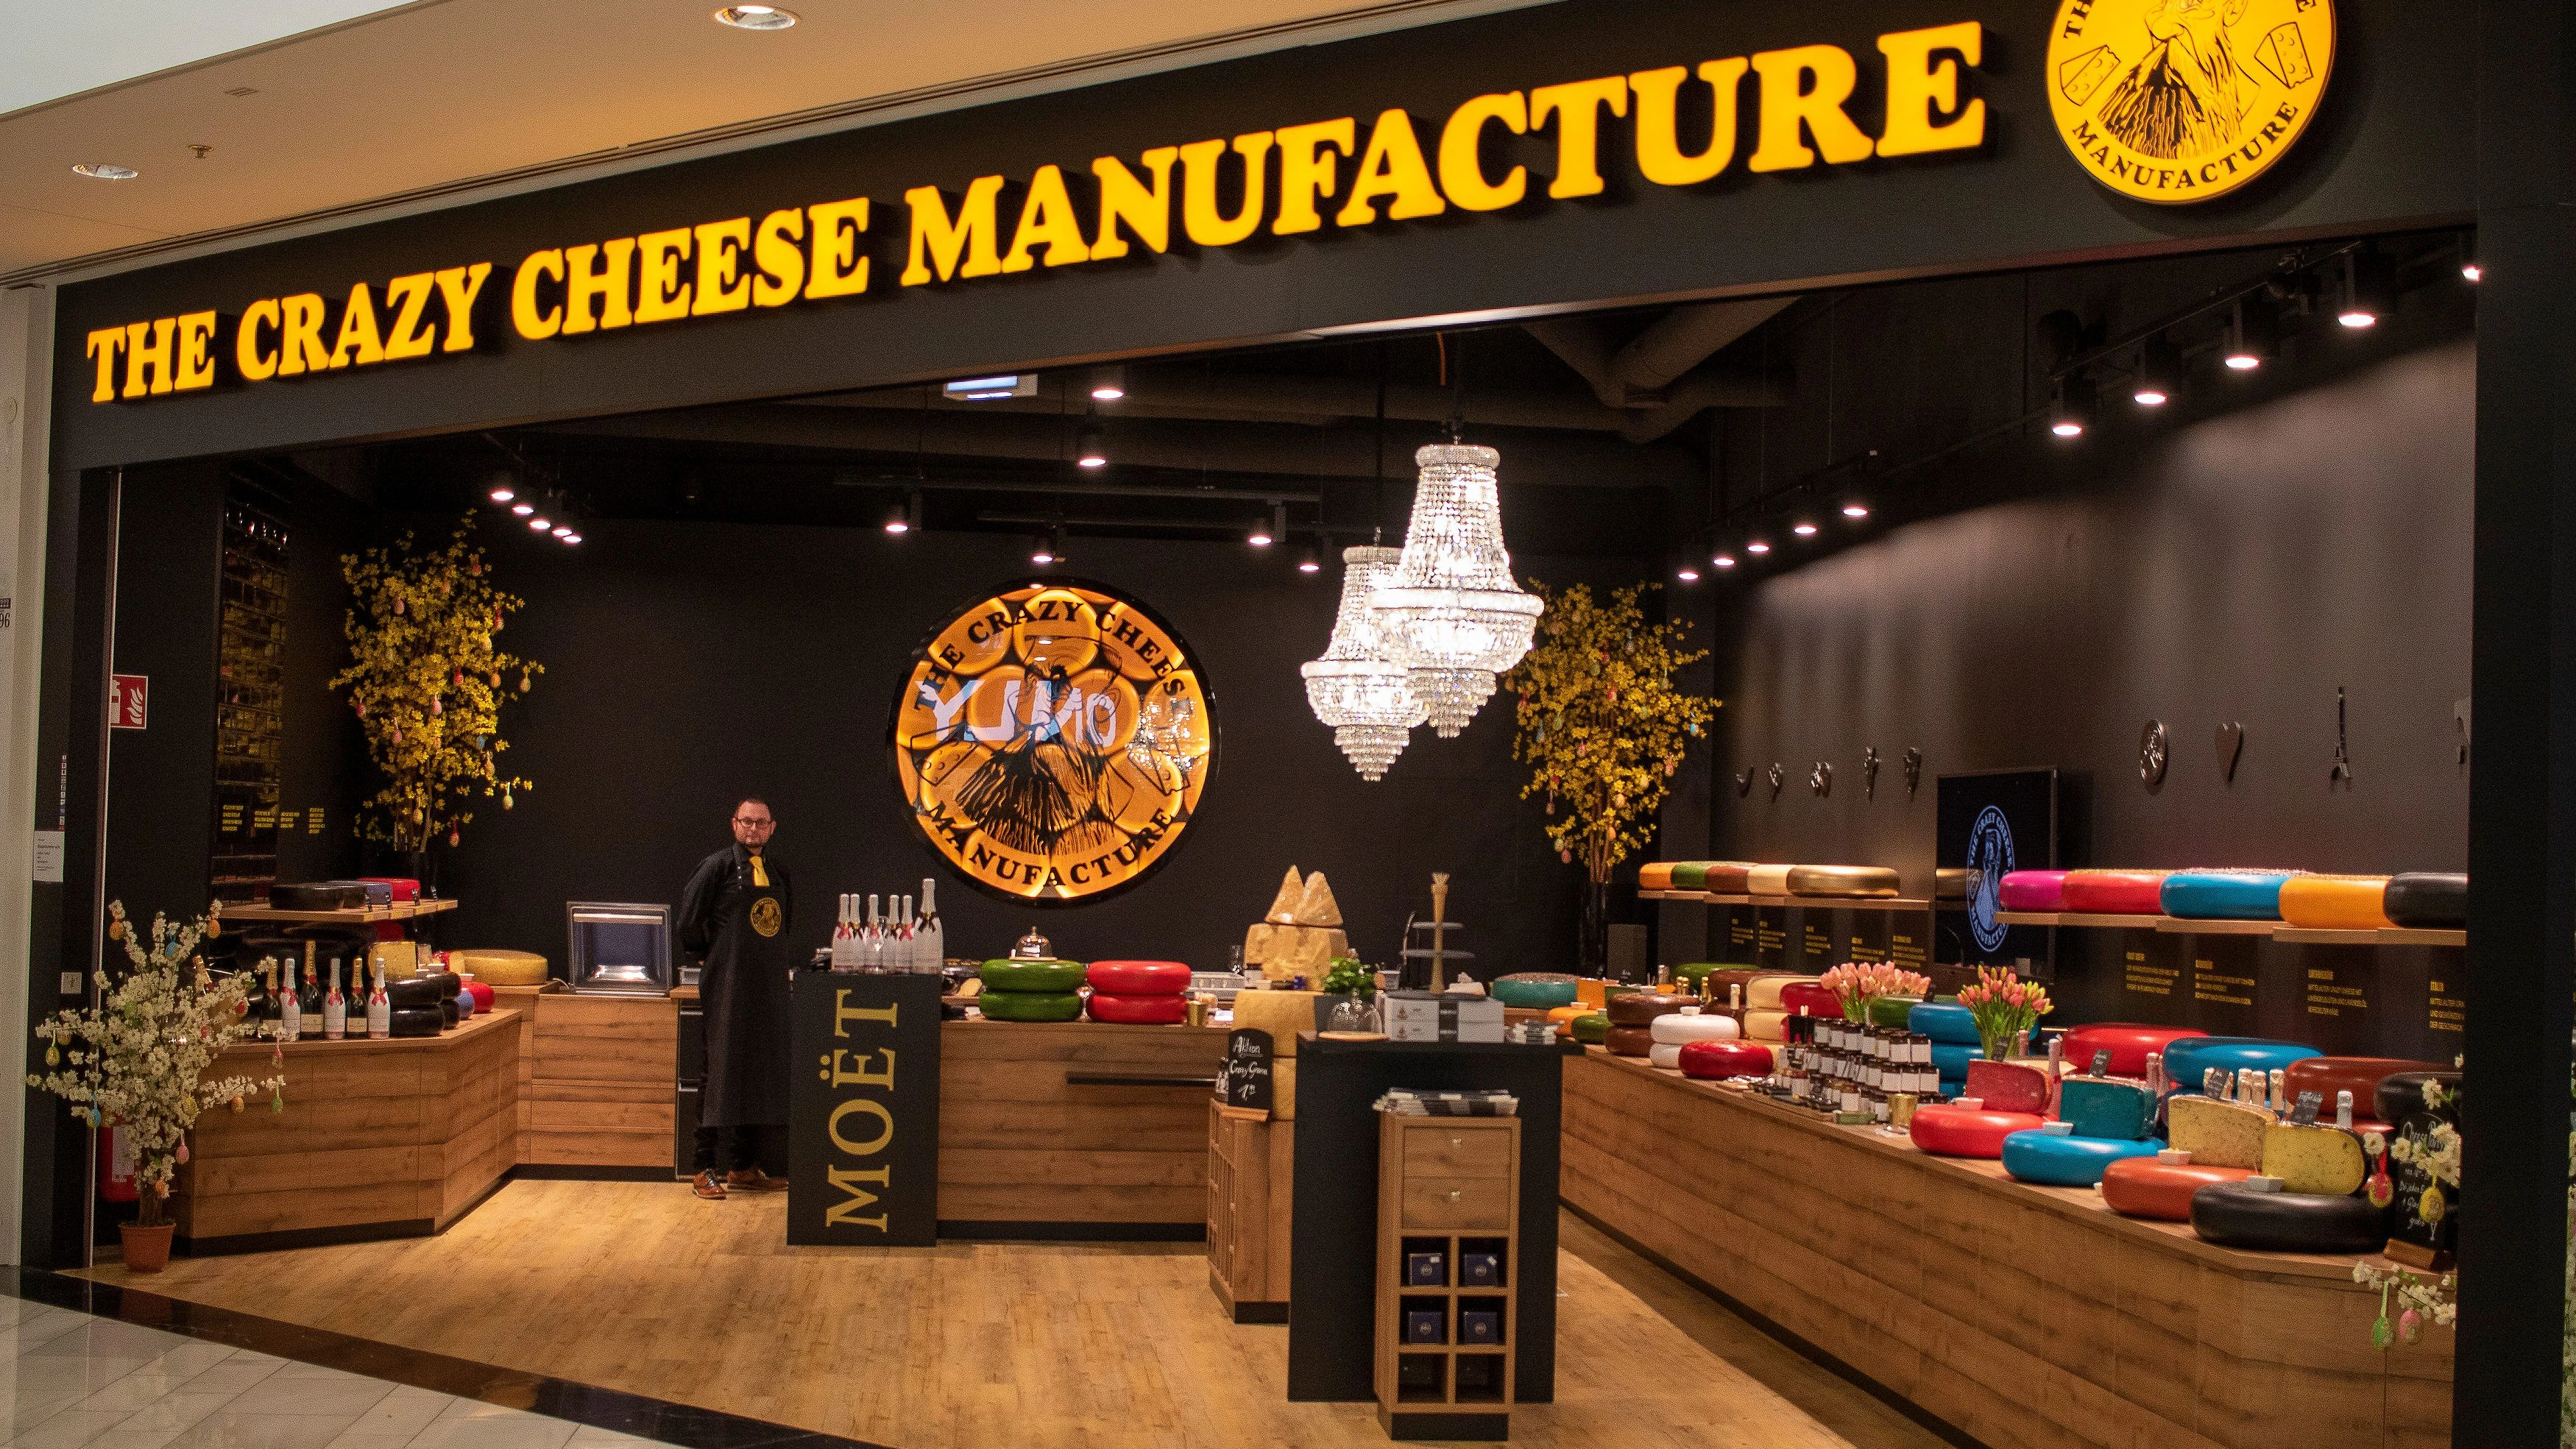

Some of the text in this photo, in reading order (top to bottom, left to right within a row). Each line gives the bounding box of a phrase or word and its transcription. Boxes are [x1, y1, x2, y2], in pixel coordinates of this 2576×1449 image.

[2063, 0, 2095, 39] TH
[2072, 102, 2299, 189] MANUFACTURE
[86, 21, 1986, 403] THE CRAZY CHEESE MANUFACTURE
[914, 643, 963, 711] THE
[969, 600, 1083, 643] CRAZY
[927, 801, 1175, 887] MANUFACTURE
[819, 988, 899, 1233] MOËT
